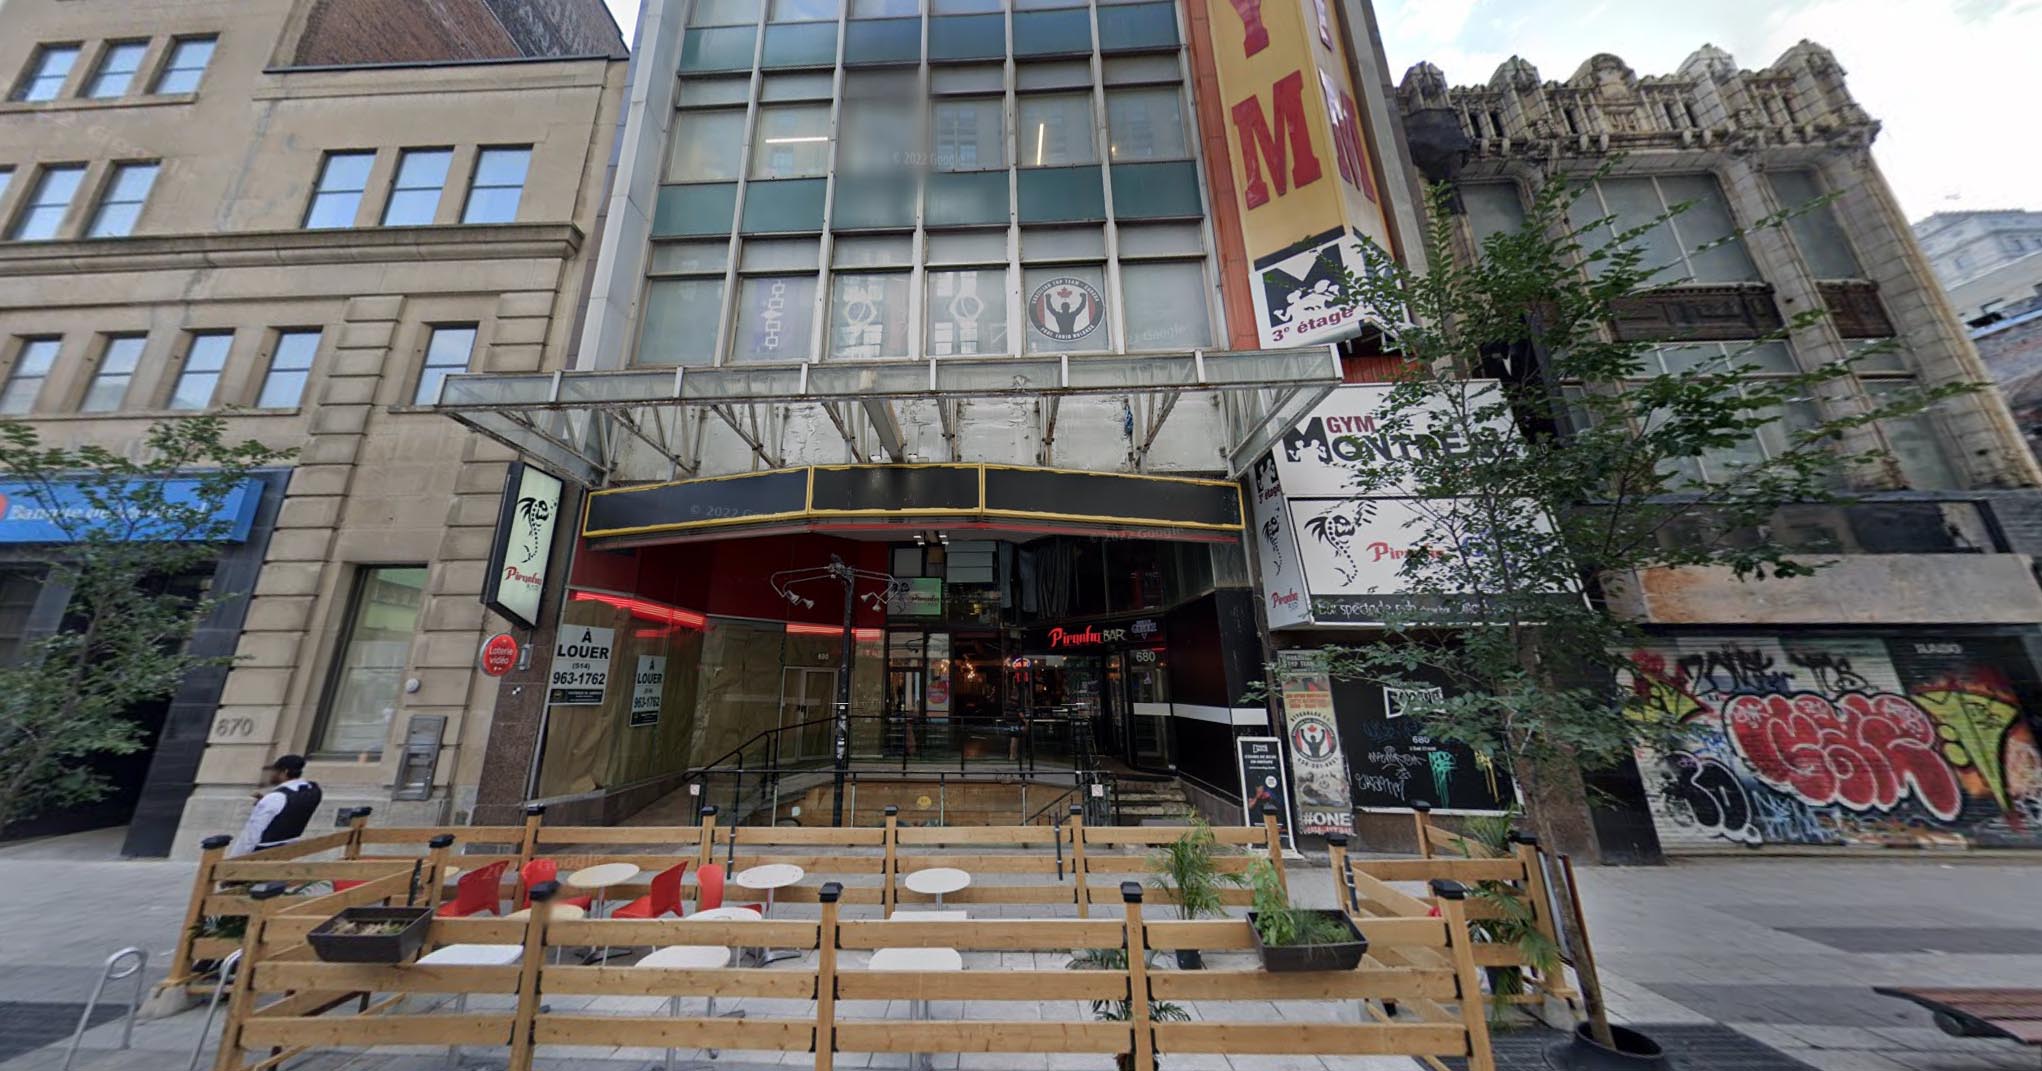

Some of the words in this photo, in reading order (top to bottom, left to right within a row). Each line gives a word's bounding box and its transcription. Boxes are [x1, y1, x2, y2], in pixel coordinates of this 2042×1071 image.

[1296, 308, 1355, 336] étage
[1327, 415, 1377, 434] GYM
[1103, 629, 1127, 642] BAR
[556, 644, 610, 660] LOUER
[1136, 652, 1156, 662] 680
[552, 671, 606, 686] 963-1762
[636, 672, 663, 685] LOUER
[216, 717, 254, 737] 670
[1411, 735, 1431, 745] 680
[1302, 811, 1352, 827] #ONE
